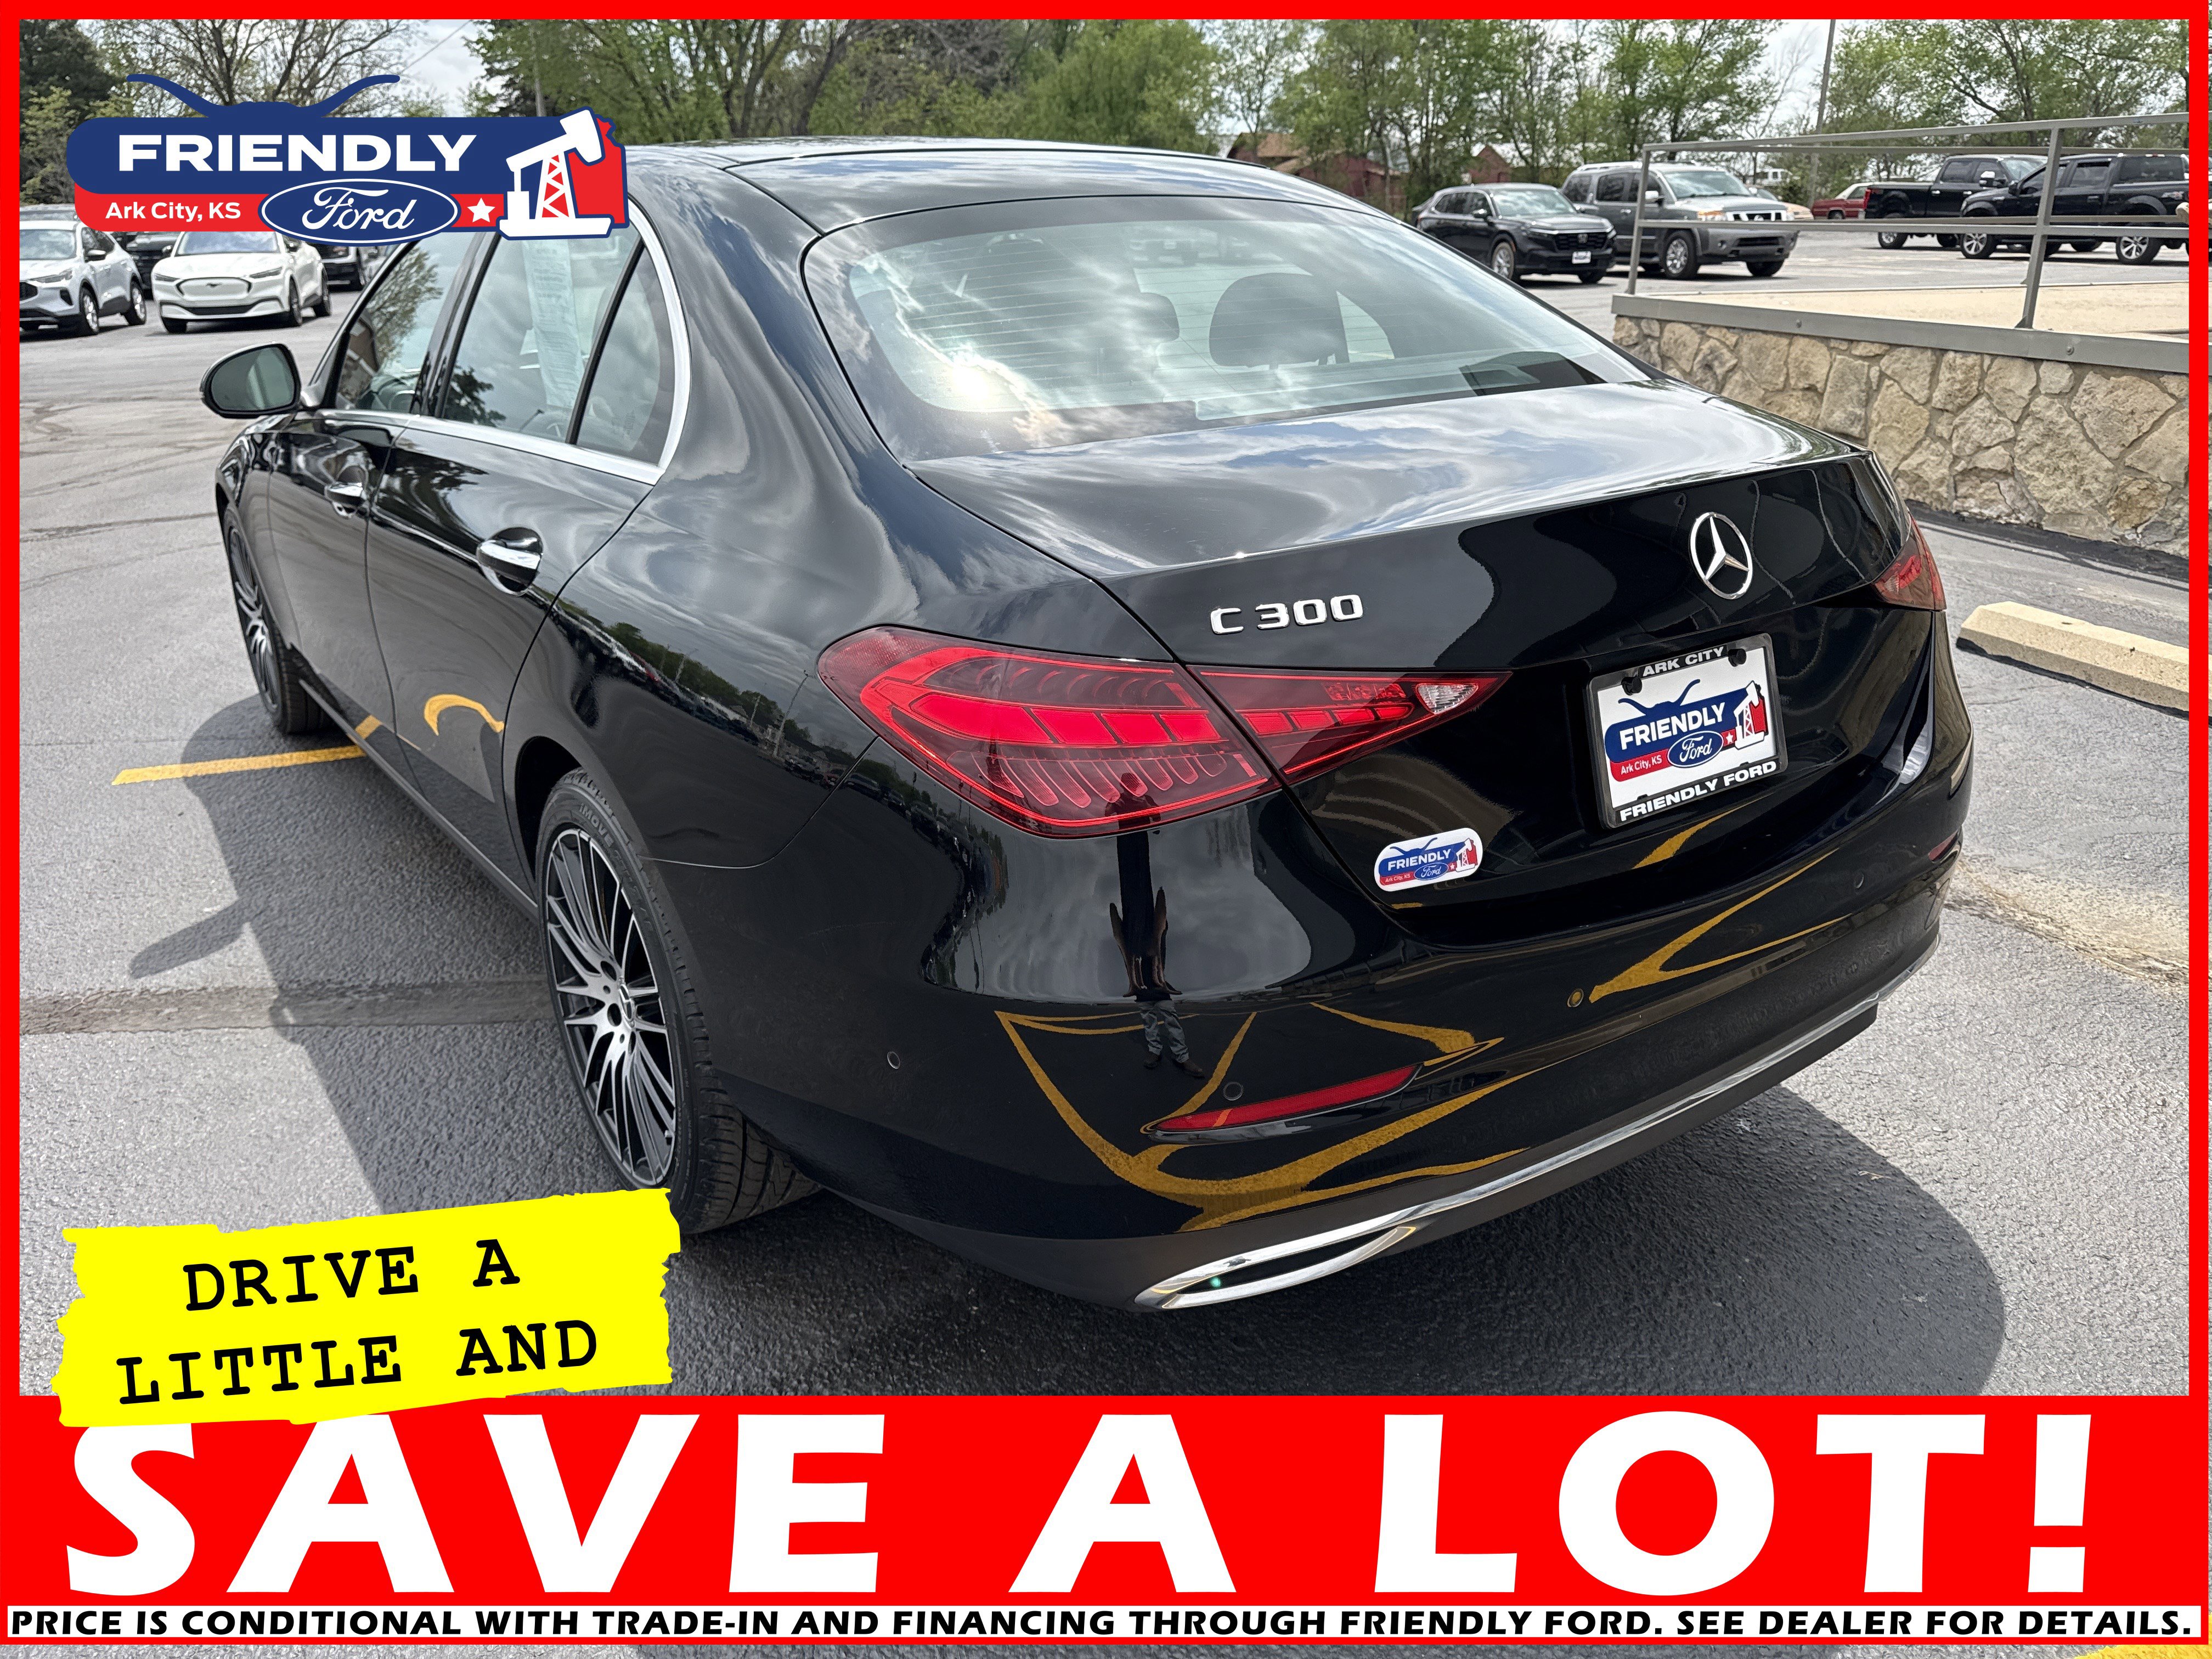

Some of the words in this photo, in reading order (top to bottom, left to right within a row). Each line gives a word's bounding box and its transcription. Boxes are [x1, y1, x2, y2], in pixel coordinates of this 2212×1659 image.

[1210, 608, 1244, 634] C
[1255, 594, 1363, 630] 300
[1643, 659, 1680, 677] ARK
[1685, 646, 1724, 666] CITY
[1619, 702, 1725, 751] FRIENDLY
[1679, 736, 1712, 763] Ford
[1621, 764, 1634, 775] Ark
[1634, 758, 1651, 771] City,
[1651, 754, 1662, 766] KS
[1620, 779, 1718, 822] FRIENDLY
[1725, 760, 1777, 787] FORD
[1387, 849, 1452, 871] FRIENDLY
[1421, 865, 1441, 878] Ford
